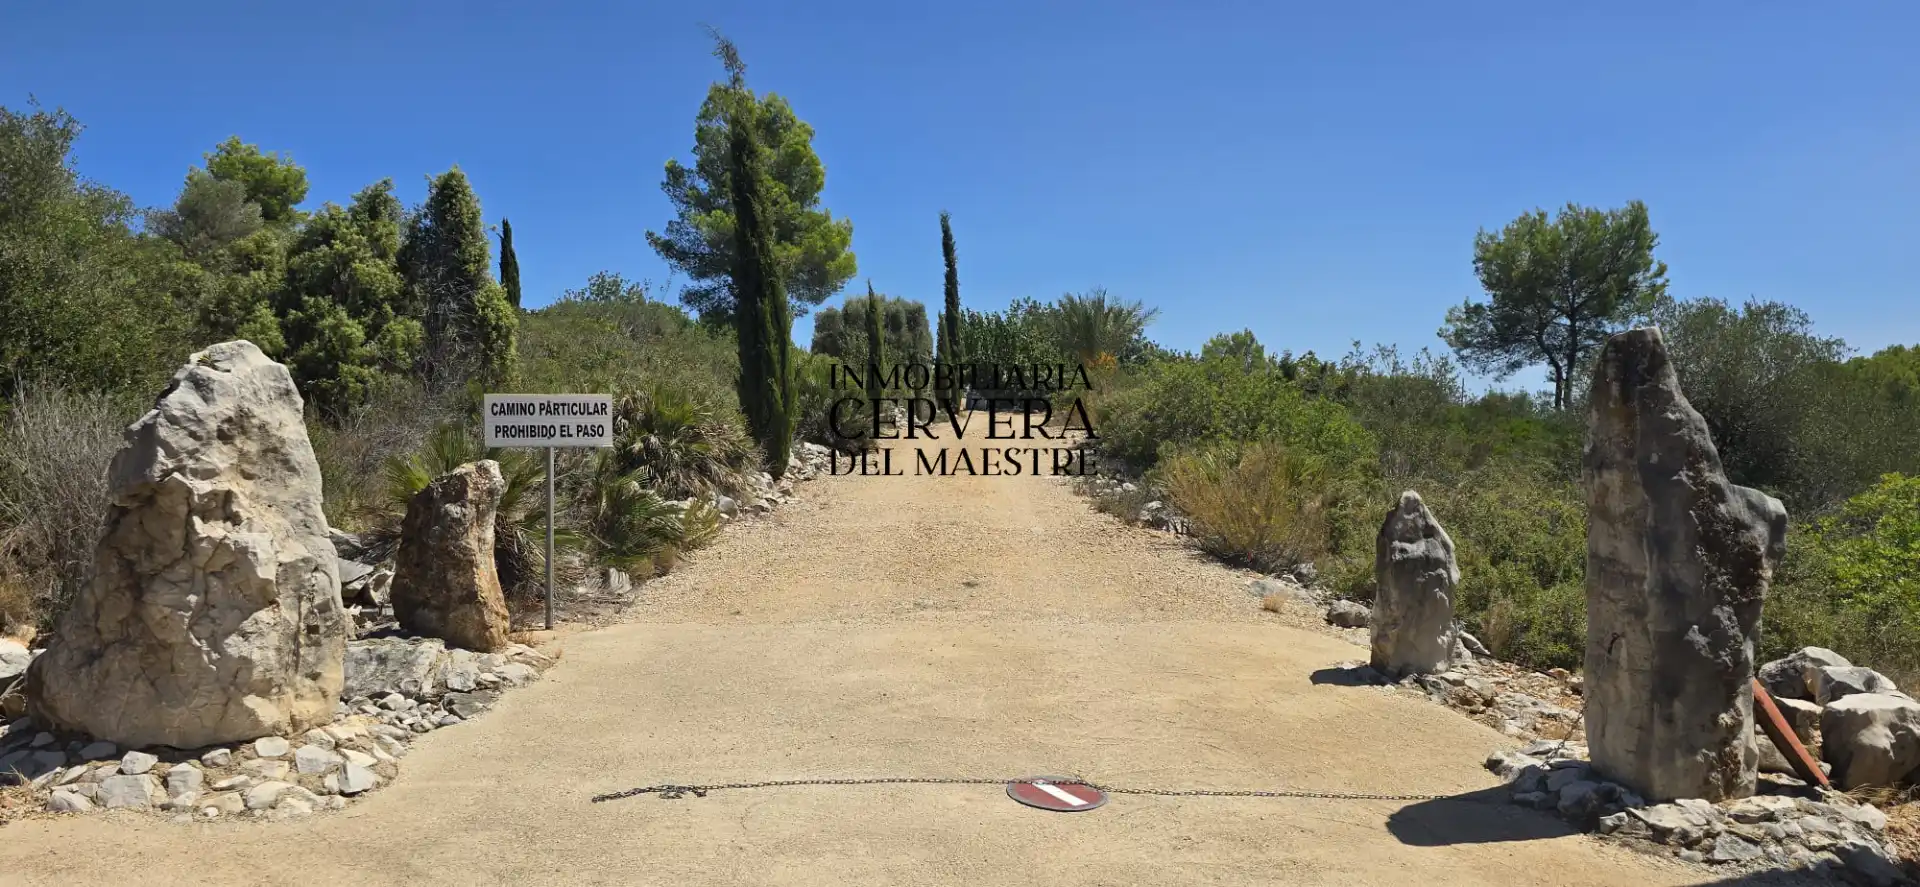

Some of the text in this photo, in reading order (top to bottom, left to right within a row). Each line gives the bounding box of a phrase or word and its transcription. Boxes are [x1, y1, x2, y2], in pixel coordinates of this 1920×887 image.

[491, 402, 608, 416] CAMINO PARTICULAR
[494, 424, 605, 439] PROHIBIDO EL PASO
